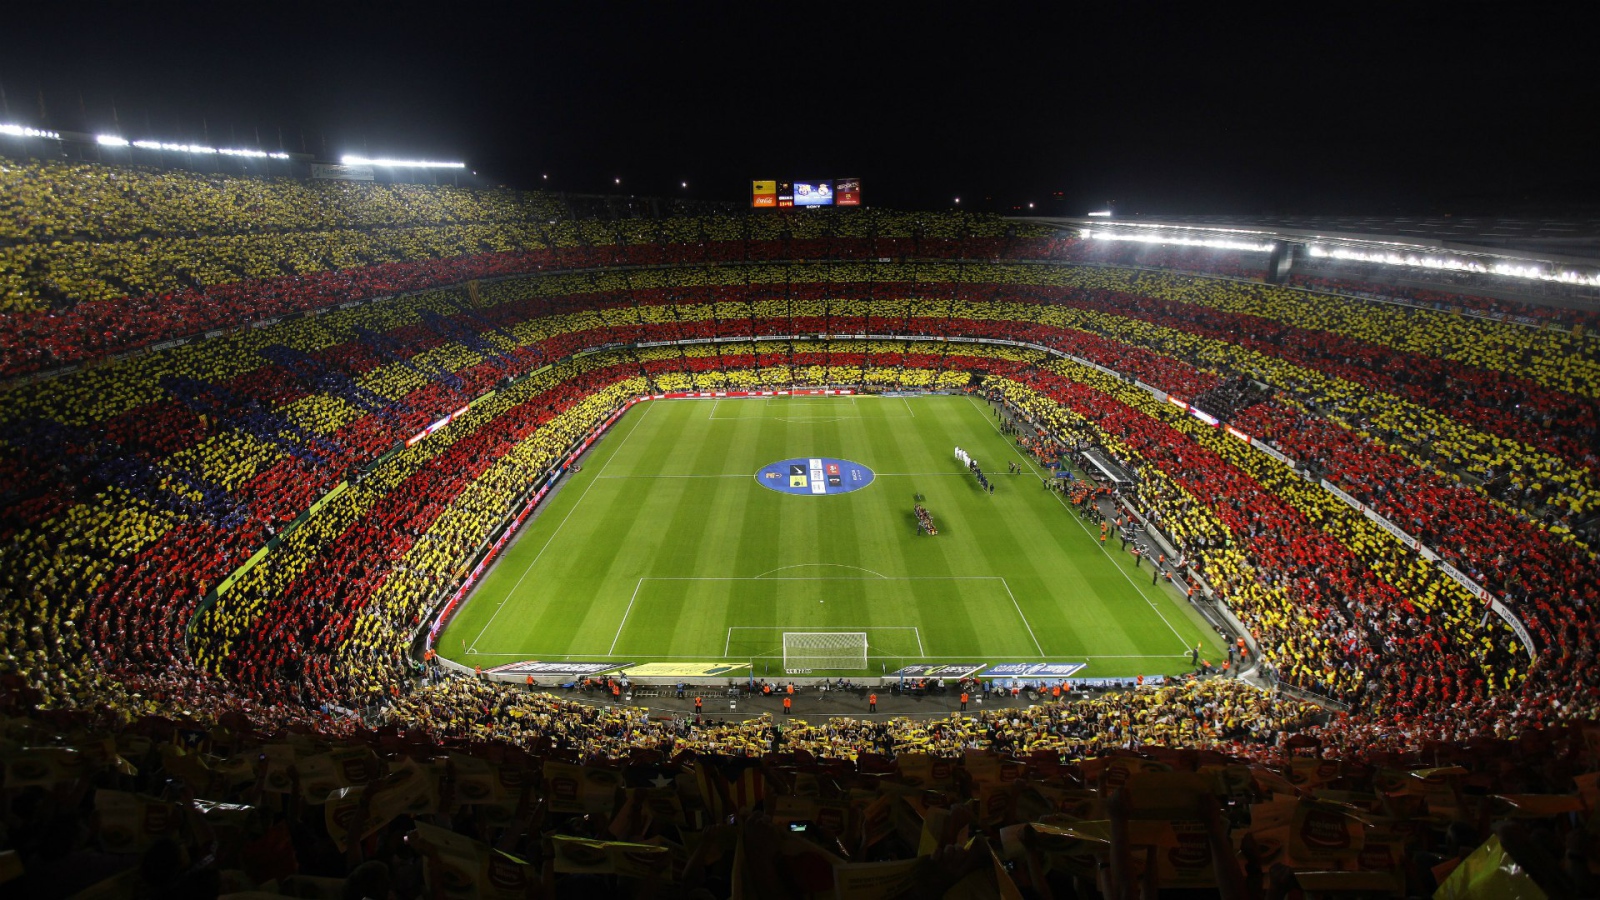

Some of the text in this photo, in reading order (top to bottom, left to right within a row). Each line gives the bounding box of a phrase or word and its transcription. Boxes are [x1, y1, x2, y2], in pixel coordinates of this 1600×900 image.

[1374, 514, 1413, 546] TURKISH AIRLINES
[1454, 571, 1479, 594] AIRLINES
[1501, 607, 1520, 631] TURKISH
